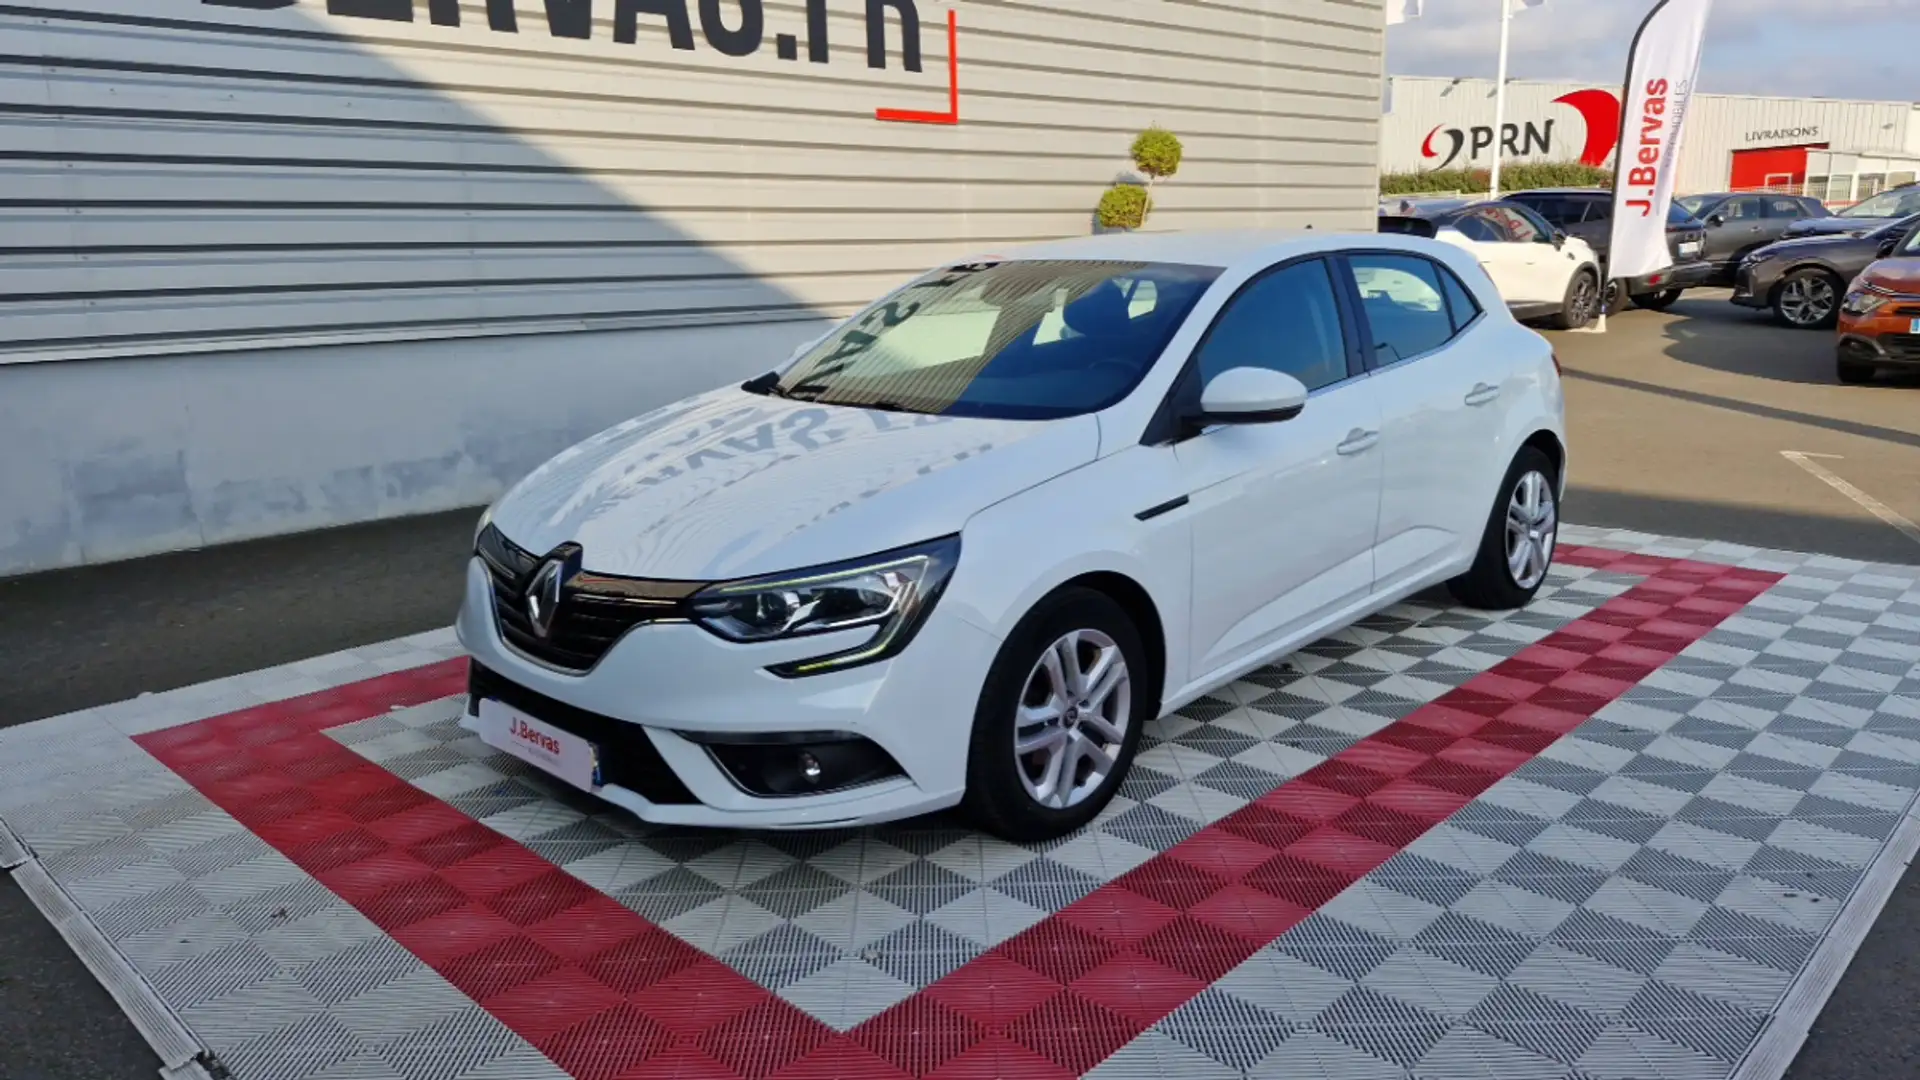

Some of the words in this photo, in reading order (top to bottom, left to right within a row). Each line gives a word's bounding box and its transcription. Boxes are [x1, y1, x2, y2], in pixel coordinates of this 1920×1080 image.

[1470, 119, 1555, 160] PRN
[1625, 78, 1668, 217] J.Bervas
[1745, 126, 1819, 143] LIVRAISONS
[510, 717, 560, 754] J.Bervas
